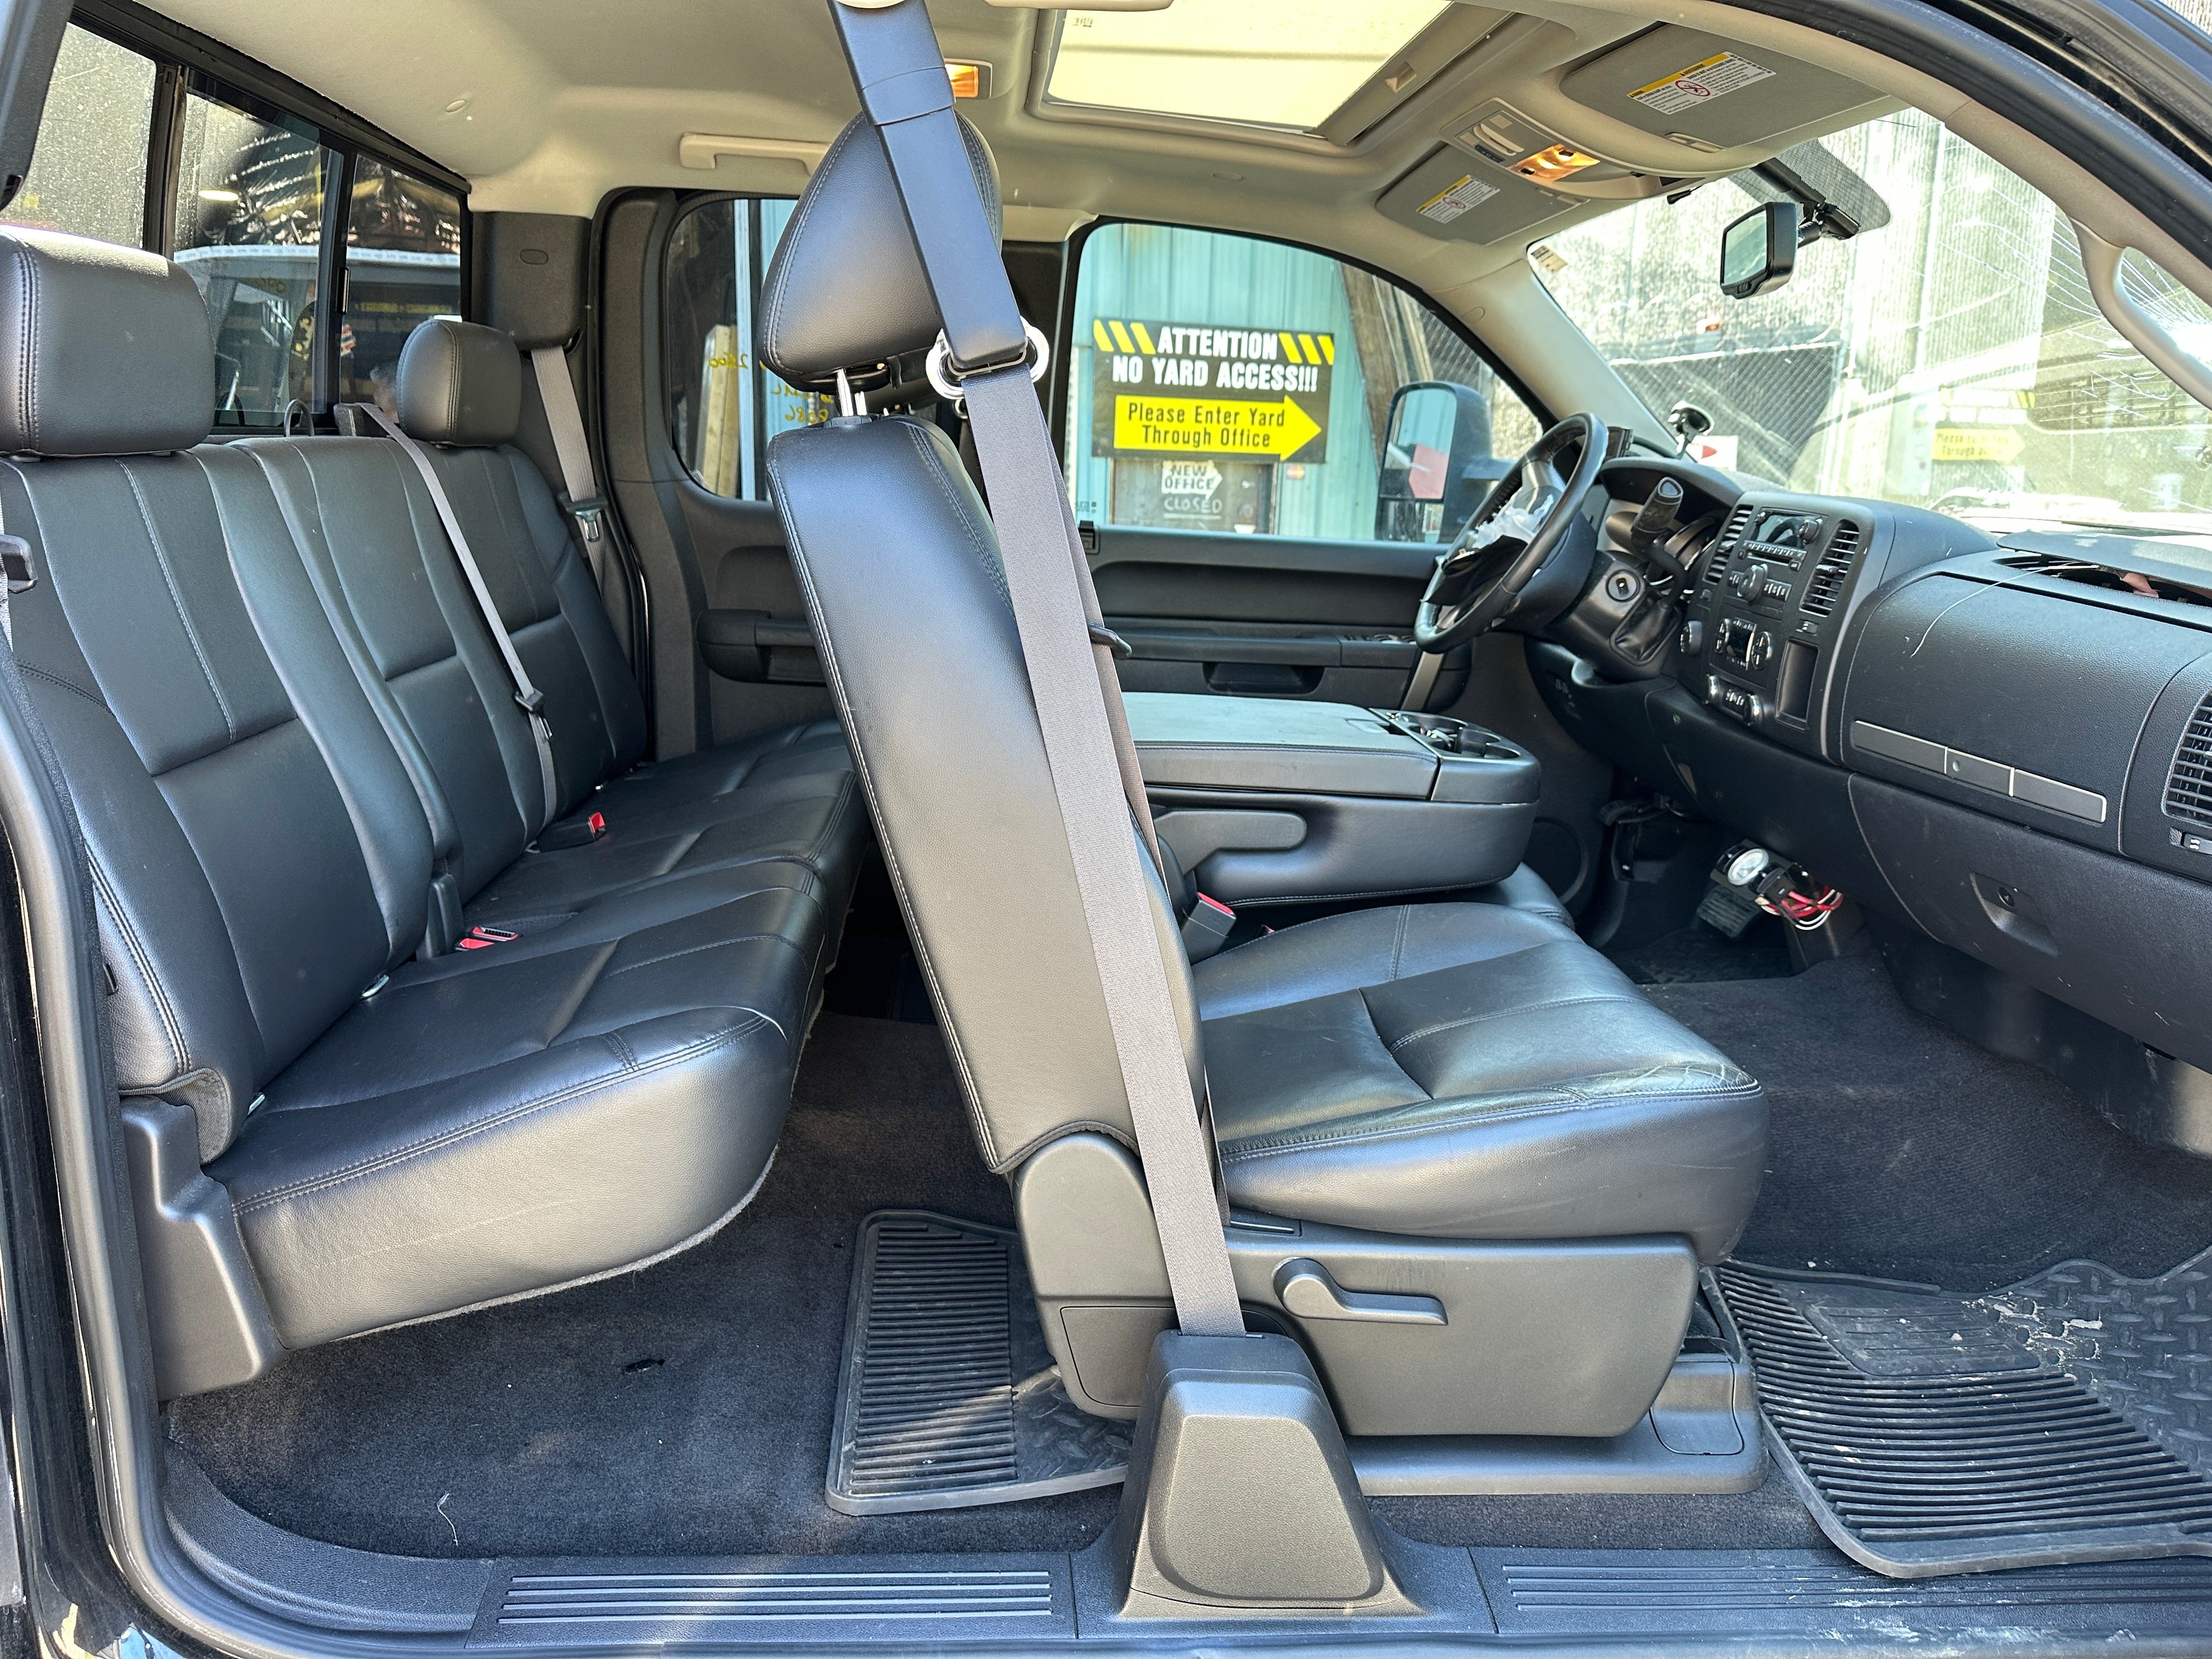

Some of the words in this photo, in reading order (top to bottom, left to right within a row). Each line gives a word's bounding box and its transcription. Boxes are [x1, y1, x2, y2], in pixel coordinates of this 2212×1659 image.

[1157, 326, 1278, 360] ATTENTION
[1112, 355, 1143, 383] NO
[1152, 357, 1209, 387] YARD
[1215, 361, 1318, 392] ACCESS!!!
[1128, 402, 1185, 423] Please
[1195, 405, 1240, 425] Enter
[1249, 408, 1285, 427] Yard
[1142, 425, 1211, 448] Through
[1221, 427, 1271, 447] Office
[1171, 464, 1207, 476] NEW
[1165, 476, 1214, 490] OFFICE
[1164, 497, 1223, 514] CLOSED
